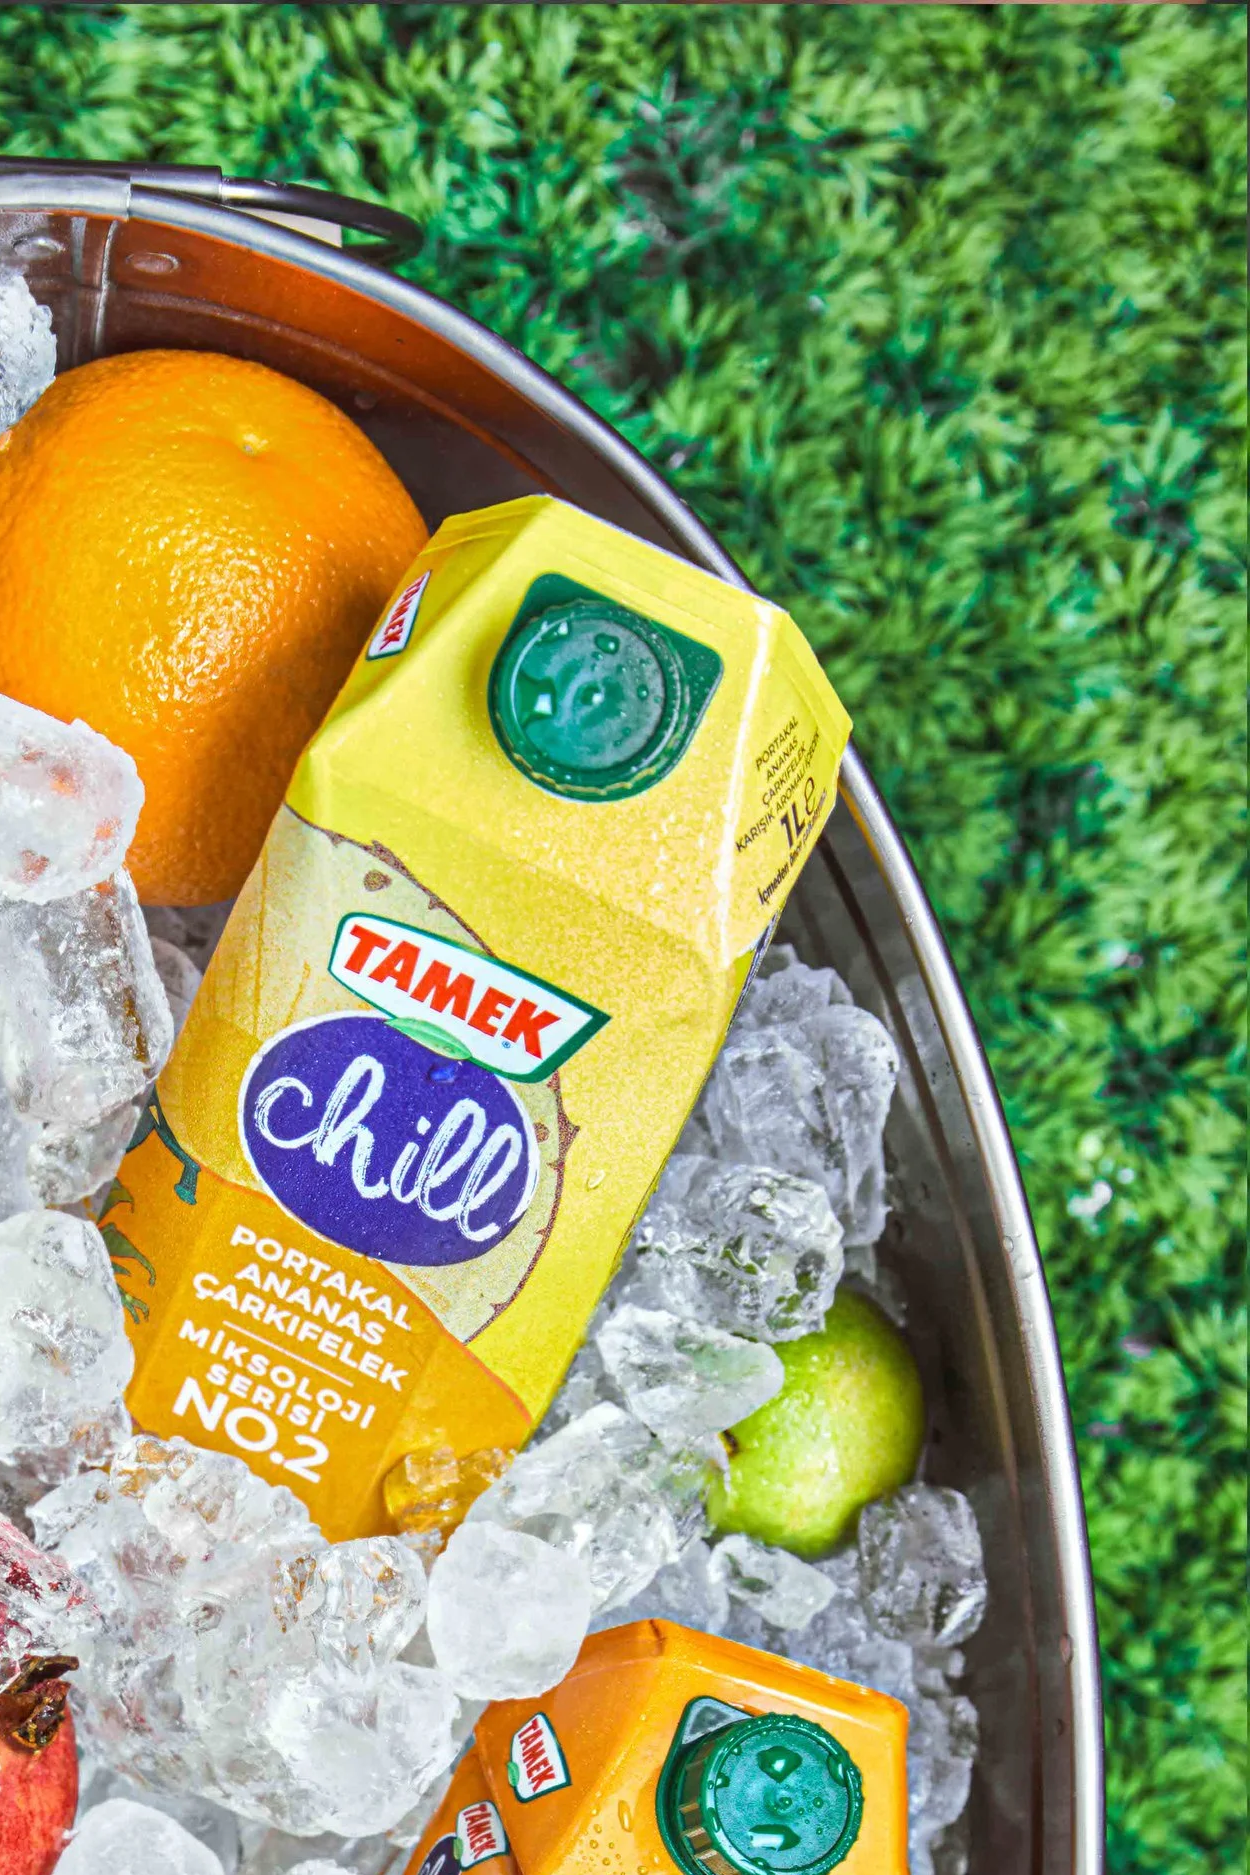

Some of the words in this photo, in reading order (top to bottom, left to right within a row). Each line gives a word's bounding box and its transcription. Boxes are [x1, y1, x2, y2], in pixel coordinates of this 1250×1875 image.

[379, 574, 426, 650] TAMEK
[755, 716, 798, 771] PORTAKAL
[762, 741, 806, 806] ÇARKIFELEK
[766, 738, 798, 781] ANANAS
[735, 808, 774, 852] KARIŞIK
[776, 767, 806, 812] AROMALI
[757, 861, 789, 905] İçmeden
[345, 924, 562, 1059] TAMEK
[255, 1055, 517, 1242] chill
[230, 1224, 412, 1332] PORTAKAL
[234, 1260, 386, 1345] ANANAS
[193, 1271, 410, 1391] ÇARKIFELEK
[179, 1320, 376, 1431] MİKSOLOJİ
[207, 1364, 324, 1432] SERİSİ
[172, 1376, 330, 1483] NO.2
[517, 1718, 556, 1793] TAMEK
[462, 1804, 496, 1859] TAMEK
